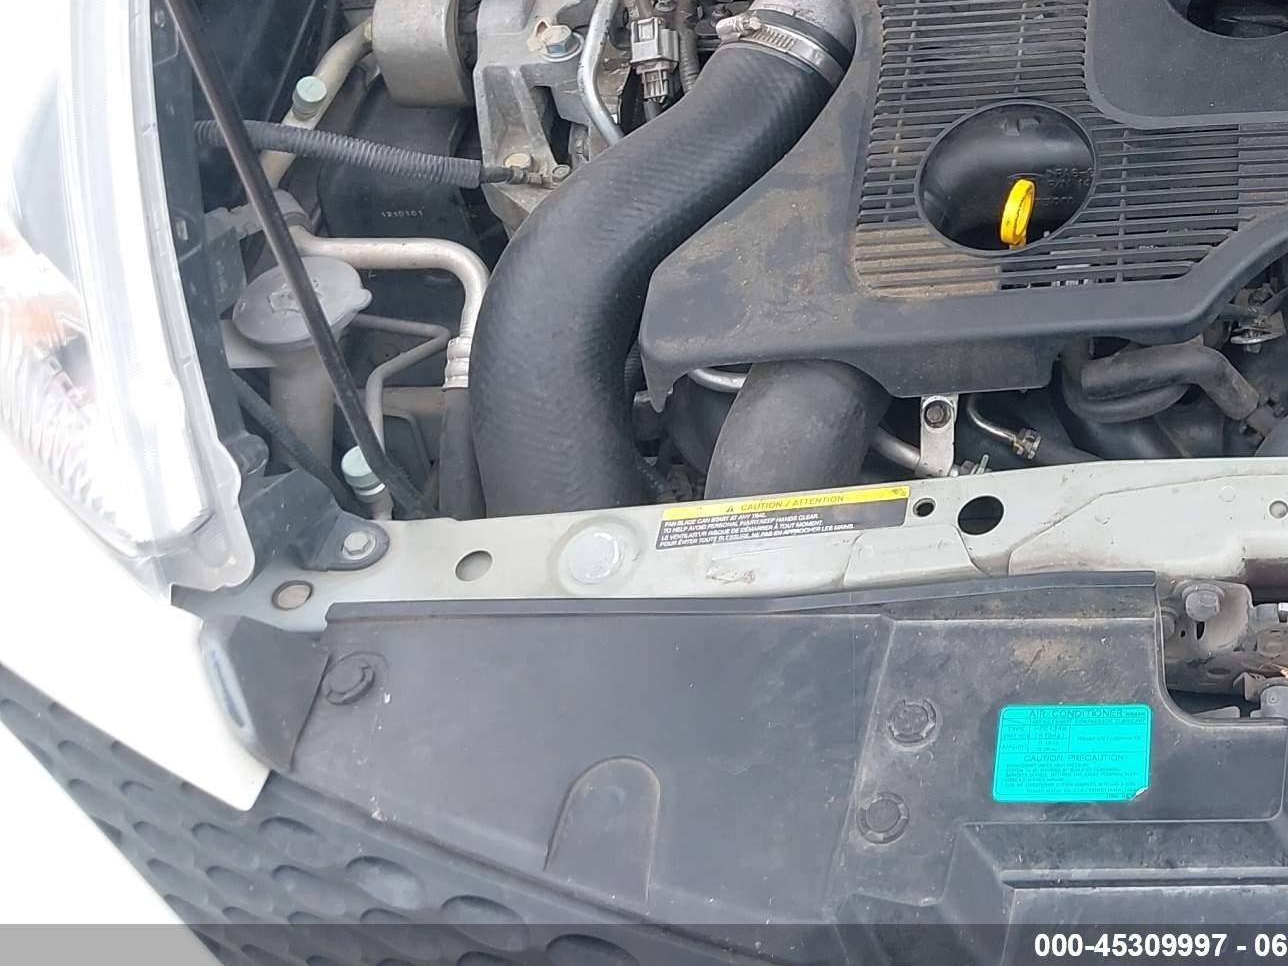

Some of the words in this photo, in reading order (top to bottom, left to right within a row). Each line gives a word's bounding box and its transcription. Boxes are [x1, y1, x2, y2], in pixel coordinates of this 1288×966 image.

[740, 500, 783, 512] CAUTION
[792, 495, 844, 507] ATTENTION
[1029, 709, 1046, 719] AIR
[1051, 708, 1124, 719] CONDITIONER
[1024, 754, 1064, 762] CAUTION
[1067, 754, 1124, 762] PRECAUTION
